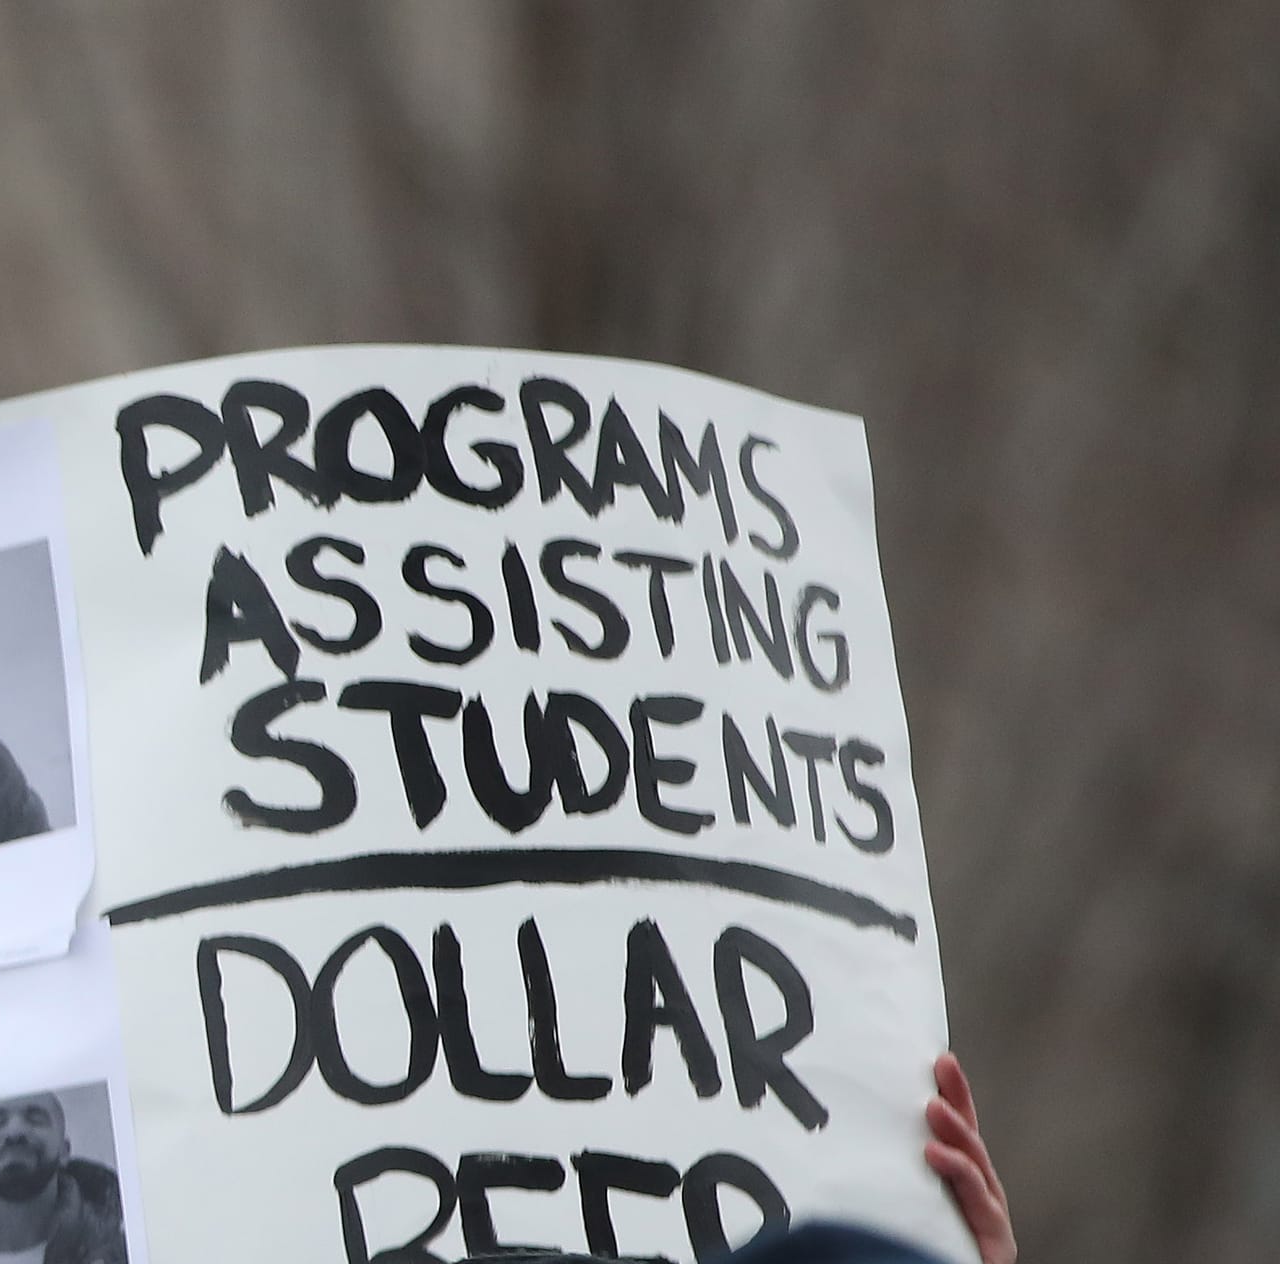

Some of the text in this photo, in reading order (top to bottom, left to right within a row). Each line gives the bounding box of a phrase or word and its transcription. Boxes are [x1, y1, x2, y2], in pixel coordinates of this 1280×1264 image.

[115, 378, 801, 562] PROGRAMS
[199, 534, 851, 693] ASSISTING
[222, 678, 896, 855] STUDENTS
[197, 916, 831, 1132] DOLLAR
